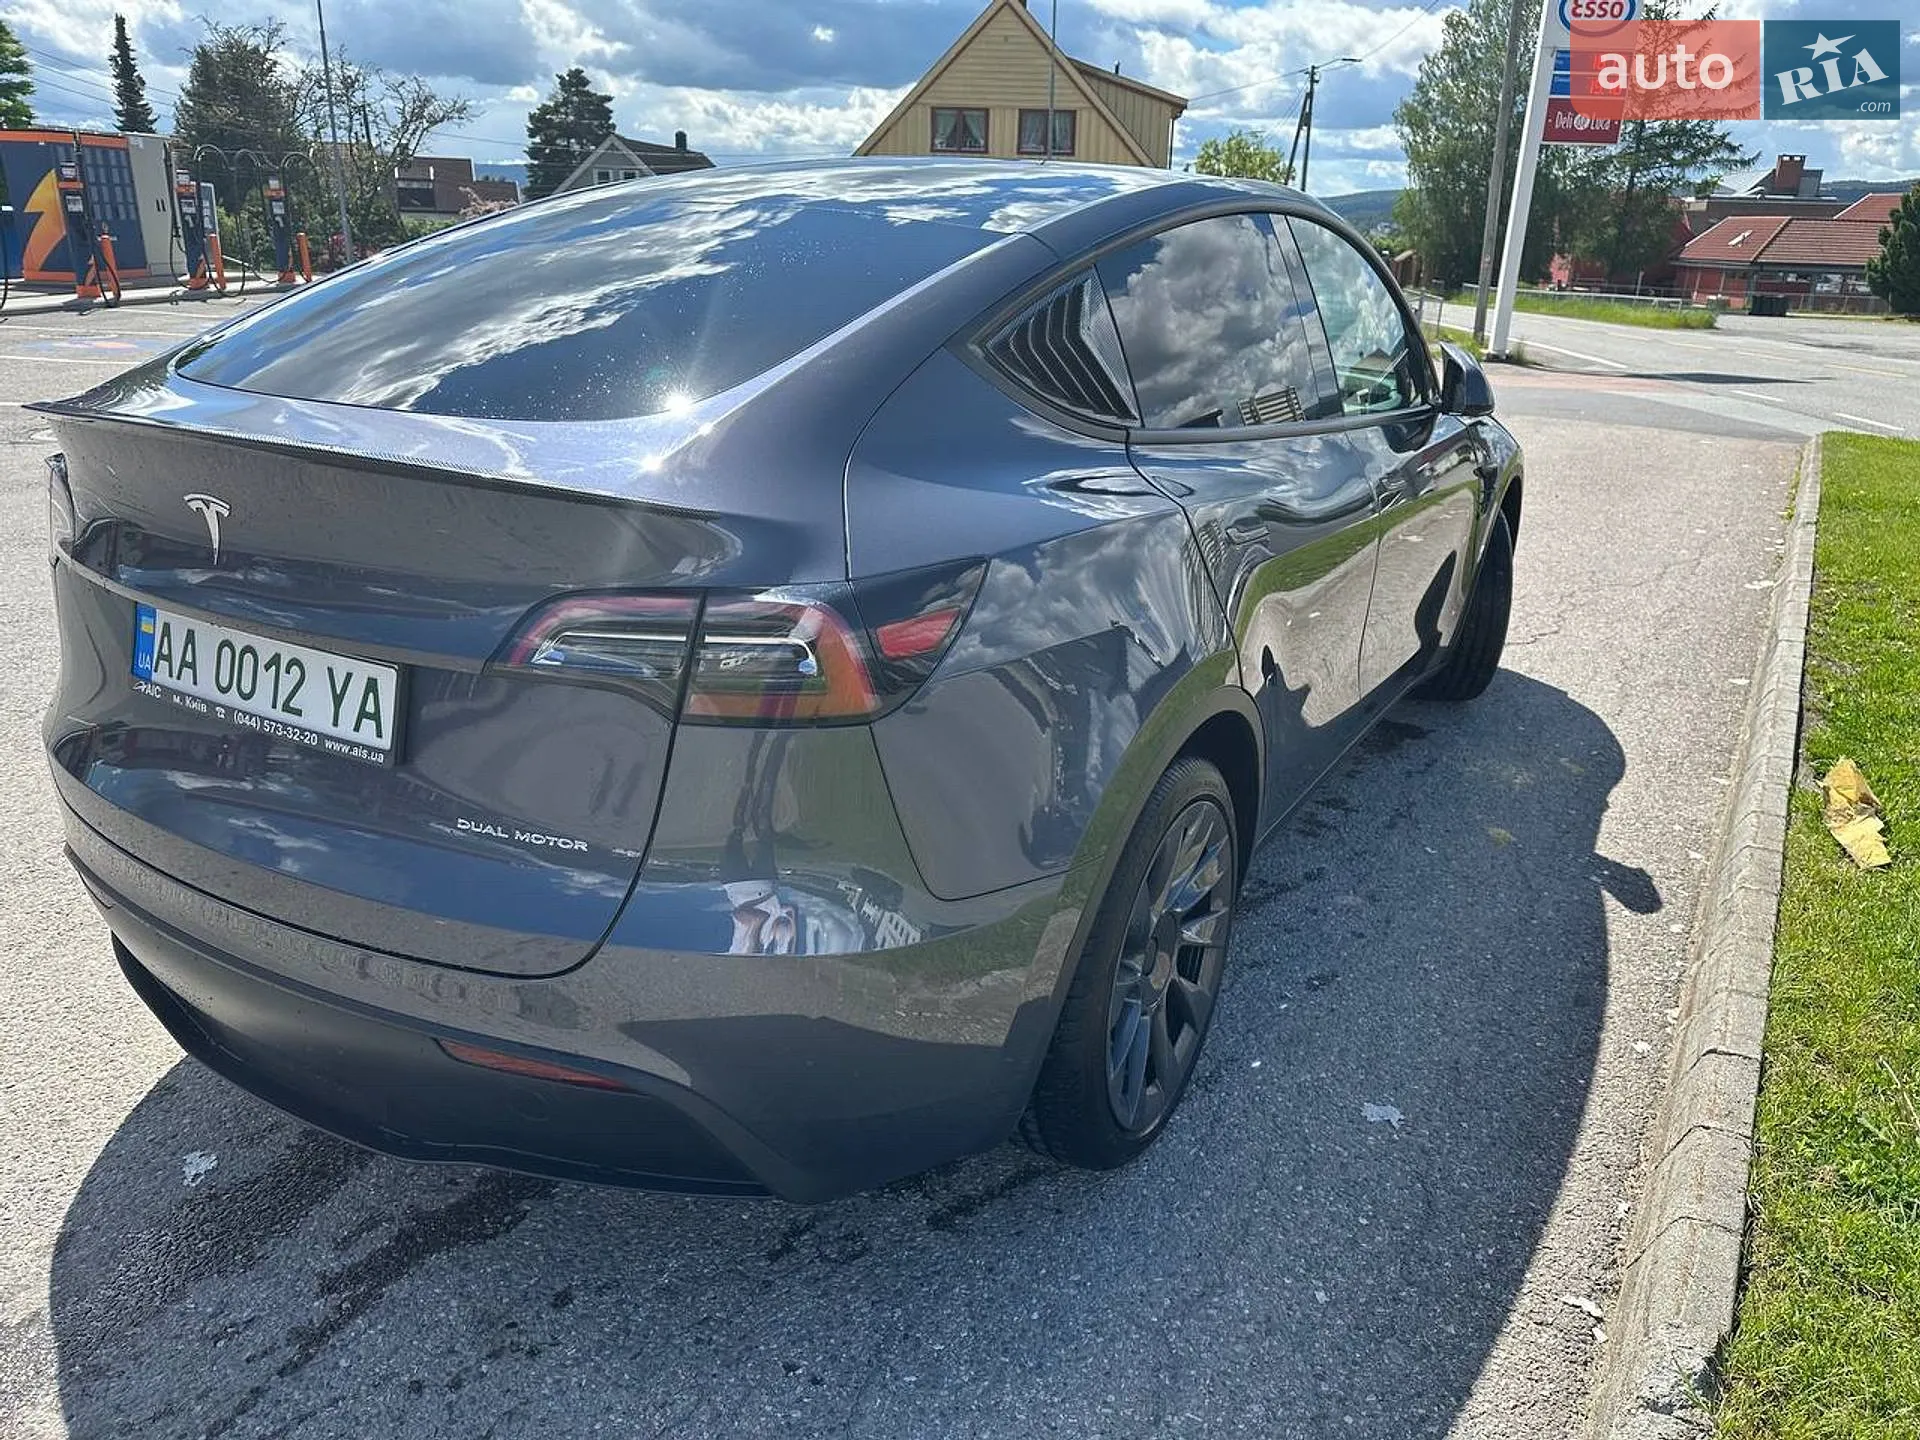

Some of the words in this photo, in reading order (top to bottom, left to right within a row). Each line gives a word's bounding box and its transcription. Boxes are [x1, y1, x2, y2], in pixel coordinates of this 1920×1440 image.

[138, 651, 151, 671] UA
[153, 622, 198, 686] AA
[214, 639, 306, 717] 0012
[327, 665, 383, 739] YA
[233, 710, 261, 731] (044)
[263, 719, 318, 746] 573-32-20
[324, 739, 384, 763] www.ais.ua
[457, 817, 509, 839] DUAL
[514, 830, 588, 852] MOTOR
